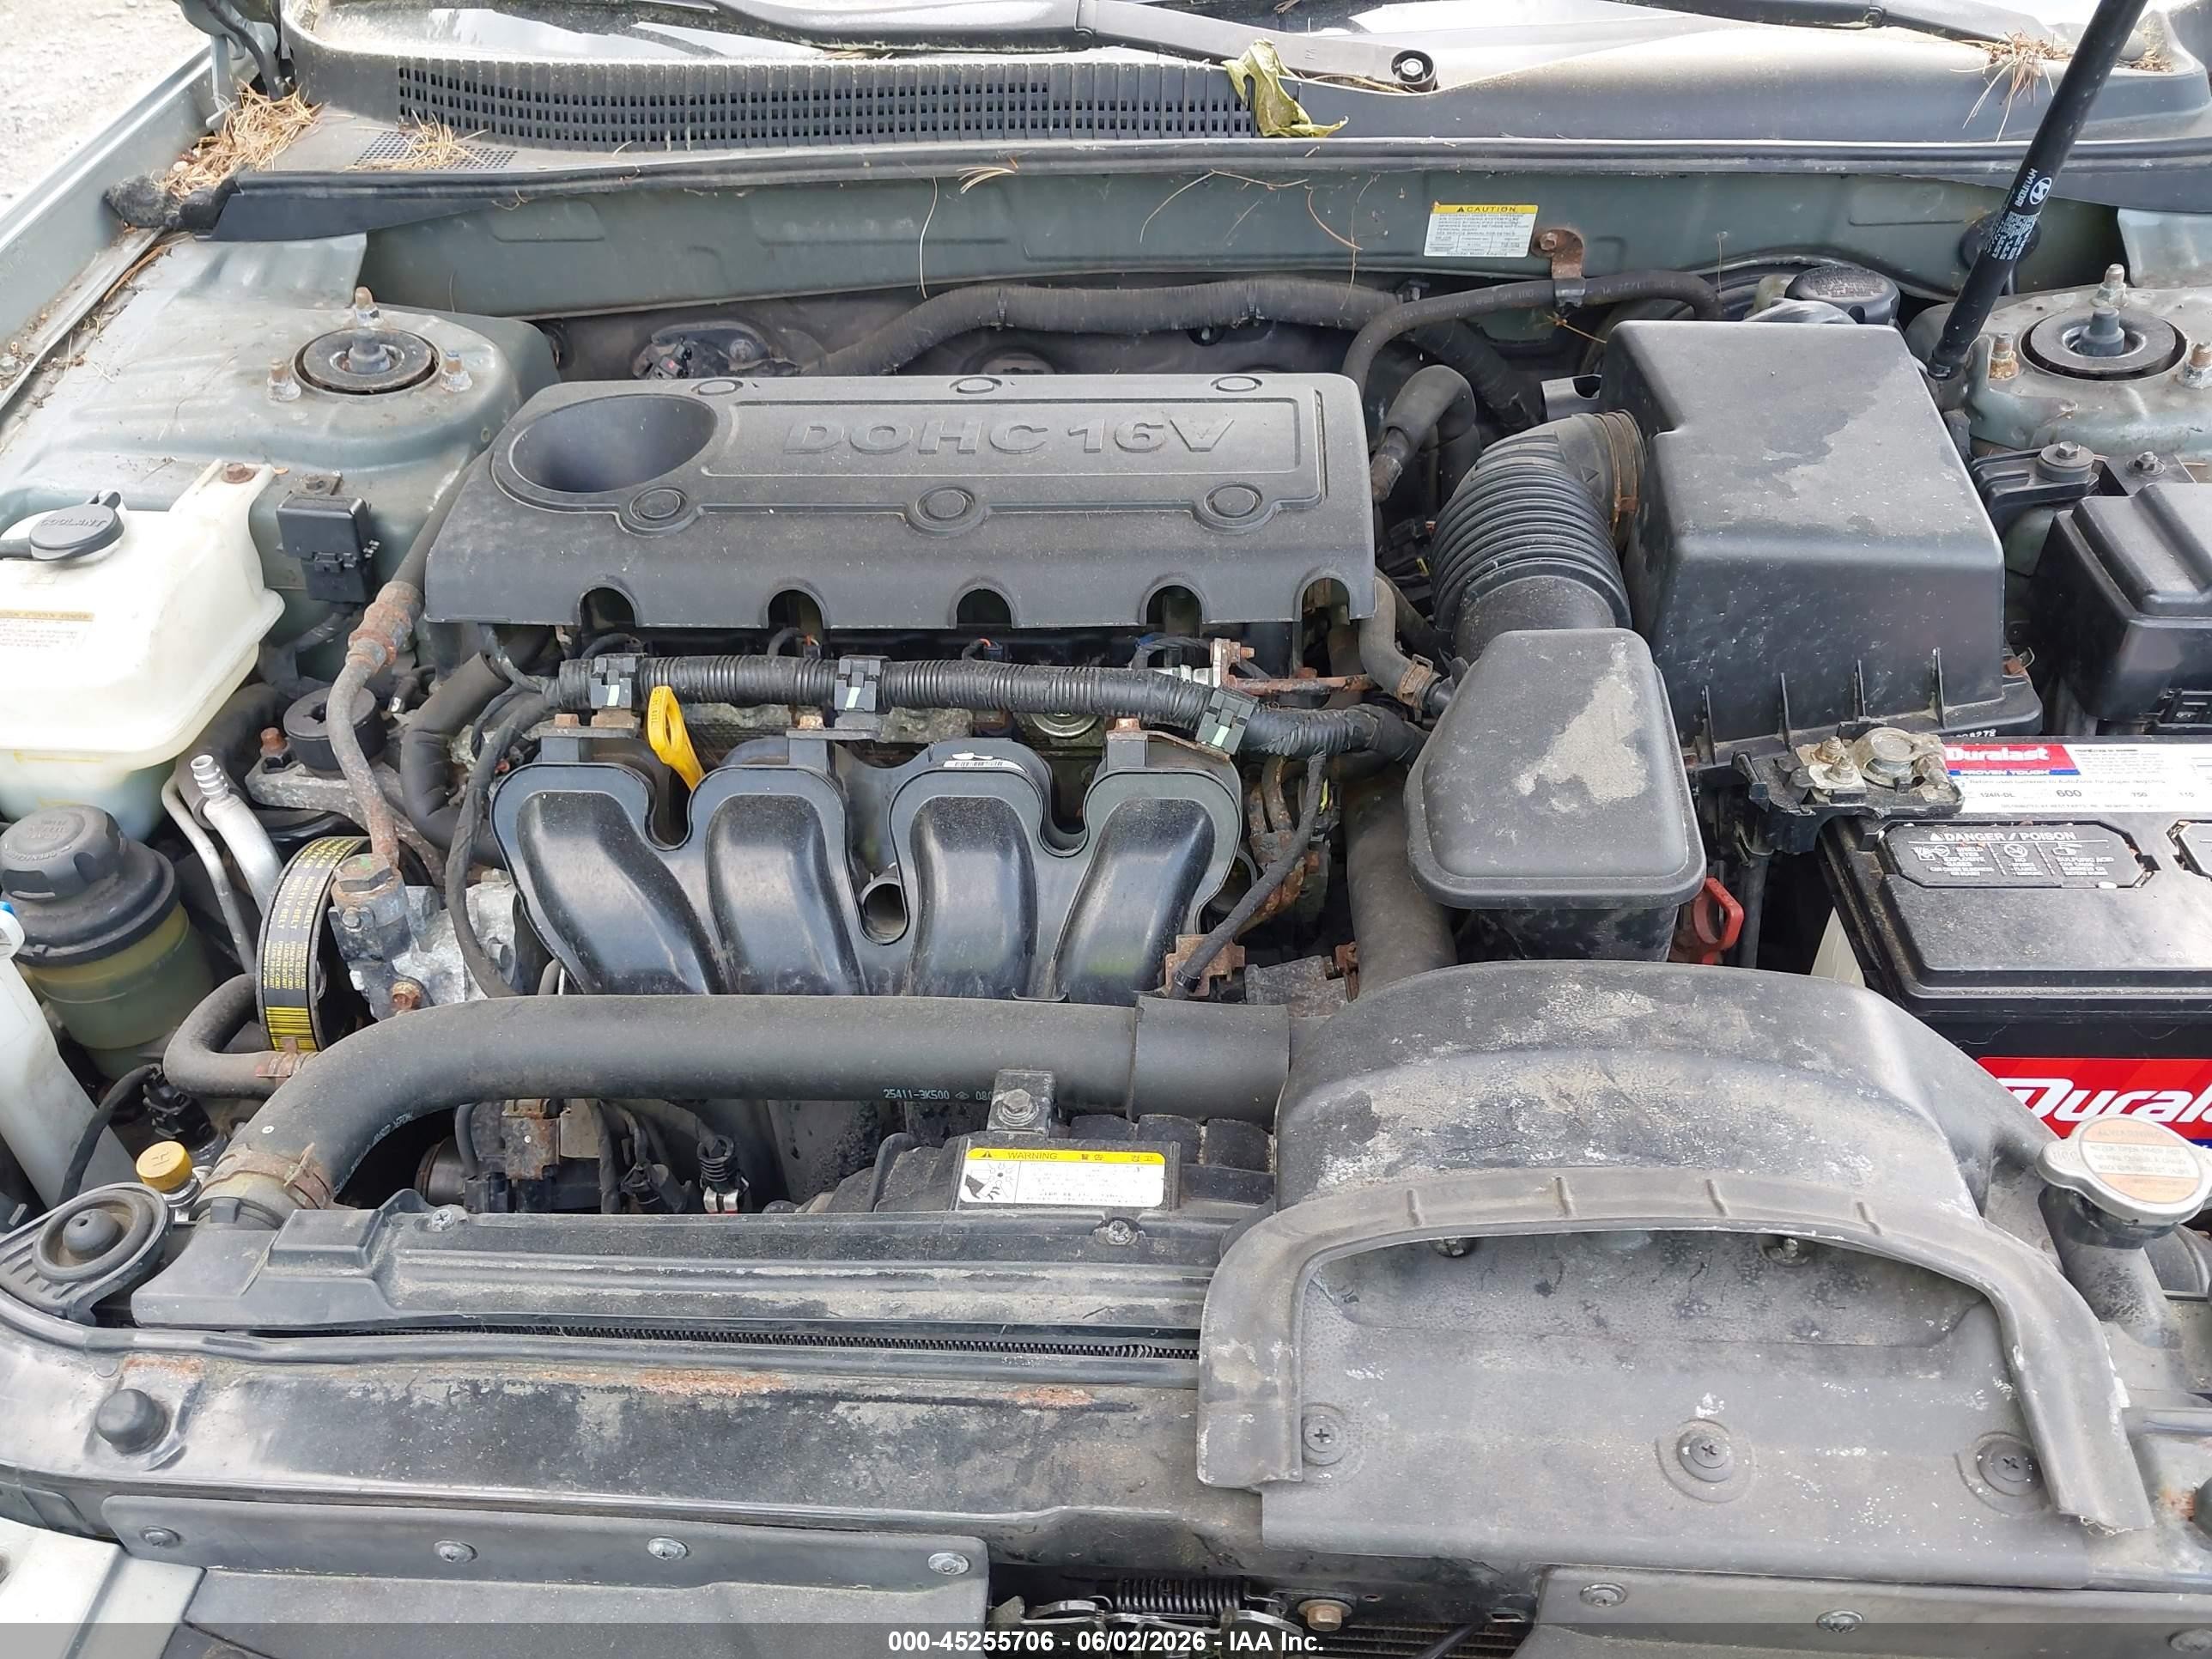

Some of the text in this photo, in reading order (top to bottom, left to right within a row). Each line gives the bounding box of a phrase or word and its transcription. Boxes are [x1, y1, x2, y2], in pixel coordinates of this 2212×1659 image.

[2014, 167, 2039, 208] HYUNDAI
[782, 417, 1236, 454] DOHC 16V
[40, 518, 108, 527] COOLANT
[1945, 746, 2051, 763] Duralast
[2056, 789, 2082, 798] 600
[2019, 832, 2076, 841] POISON
[883, 1088, 951, 1101] 25411-3K500
[1007, 1152, 1058, 1161] WARNING
